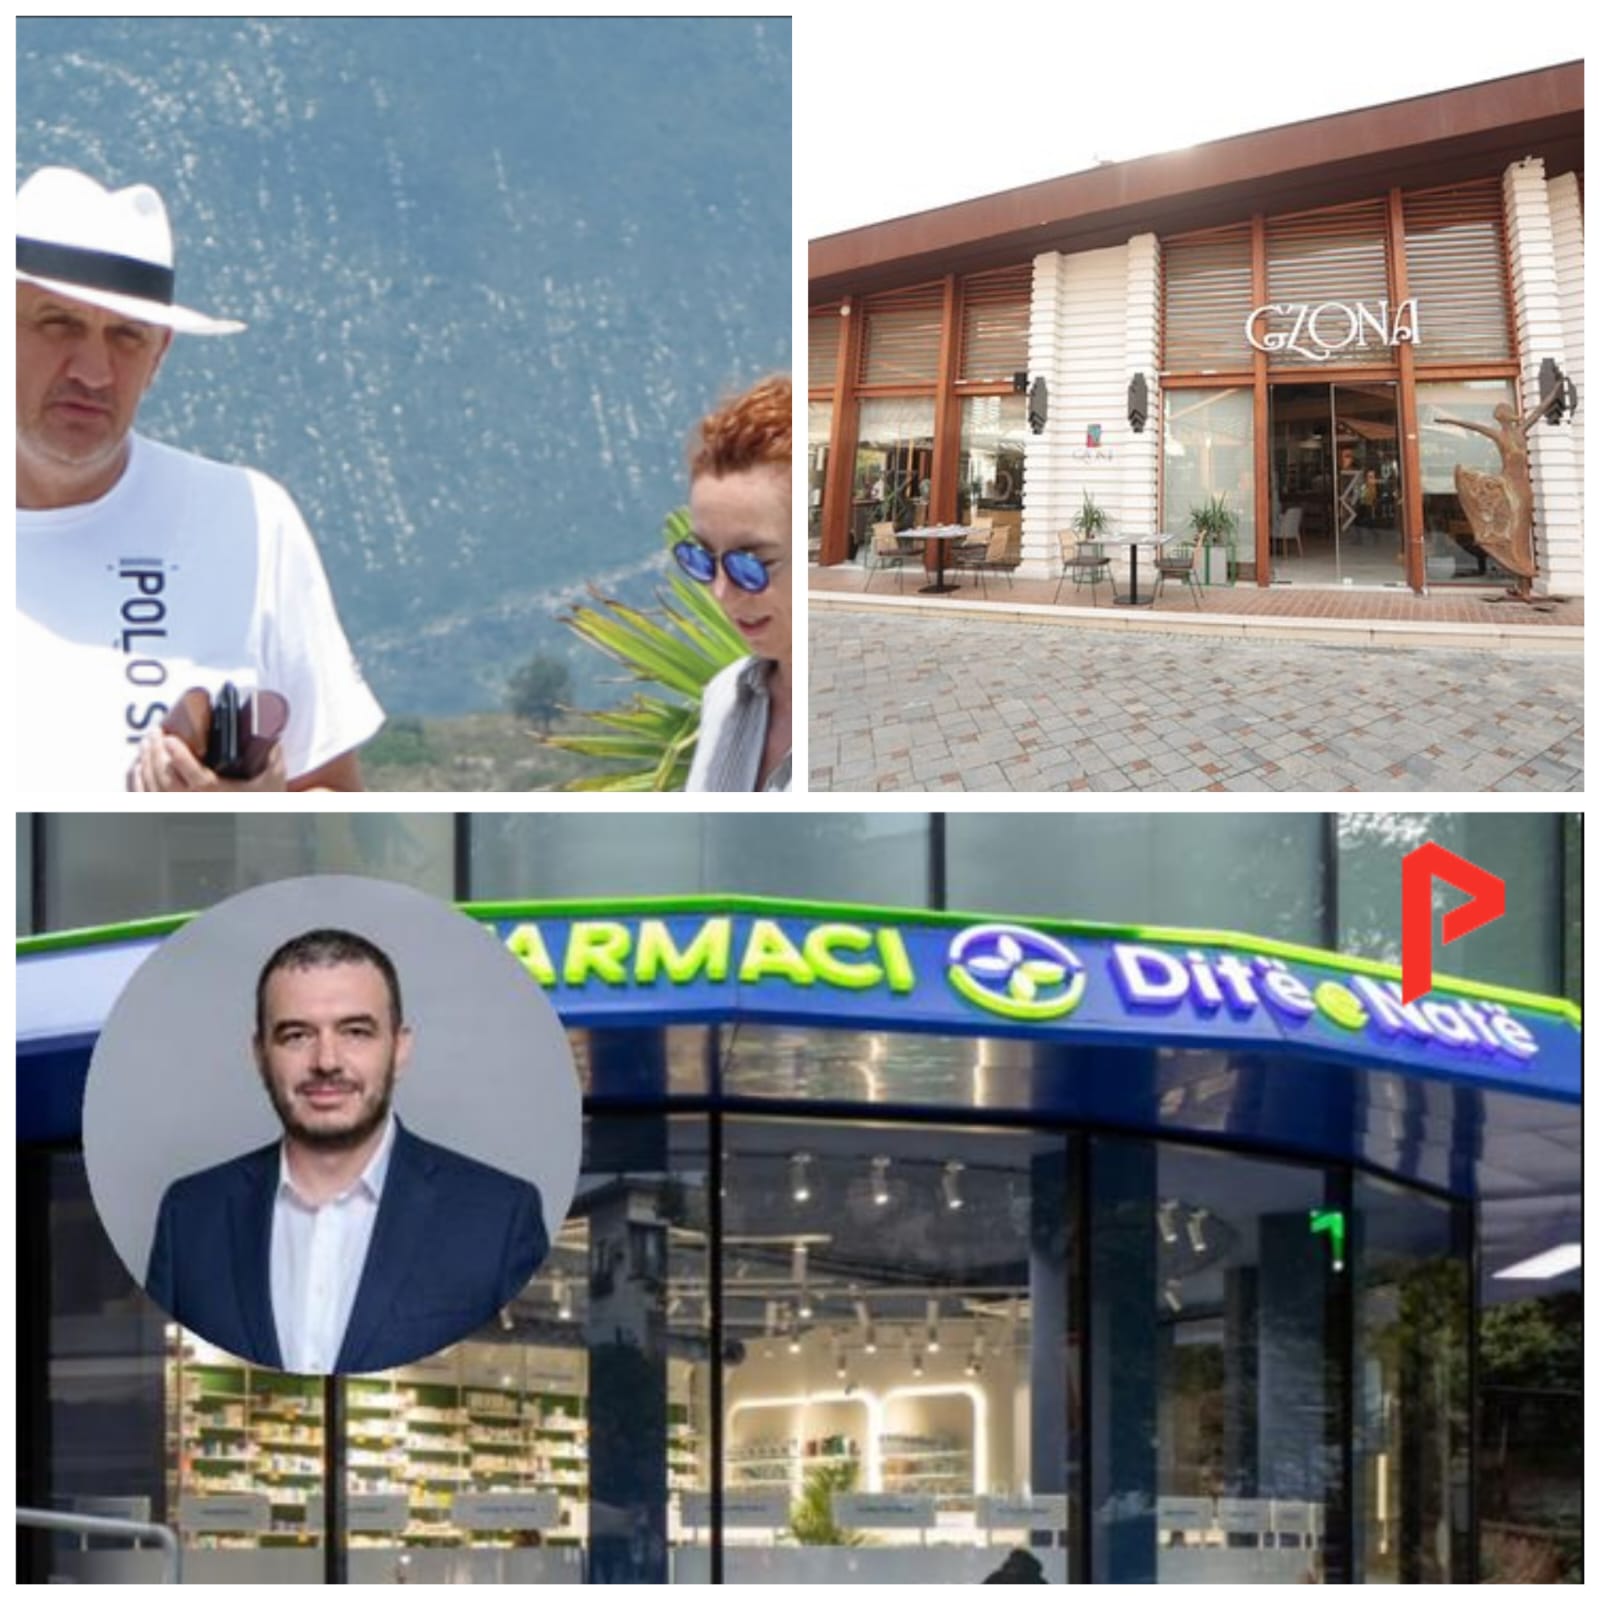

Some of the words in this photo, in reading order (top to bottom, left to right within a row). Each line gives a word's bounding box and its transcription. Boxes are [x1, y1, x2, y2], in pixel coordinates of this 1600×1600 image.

[125, 702, 170, 744] S
[487, 918, 916, 993] ARMACI
[1109, 943, 1317, 1027] Ditë
[1315, 980, 1369, 1031] e
